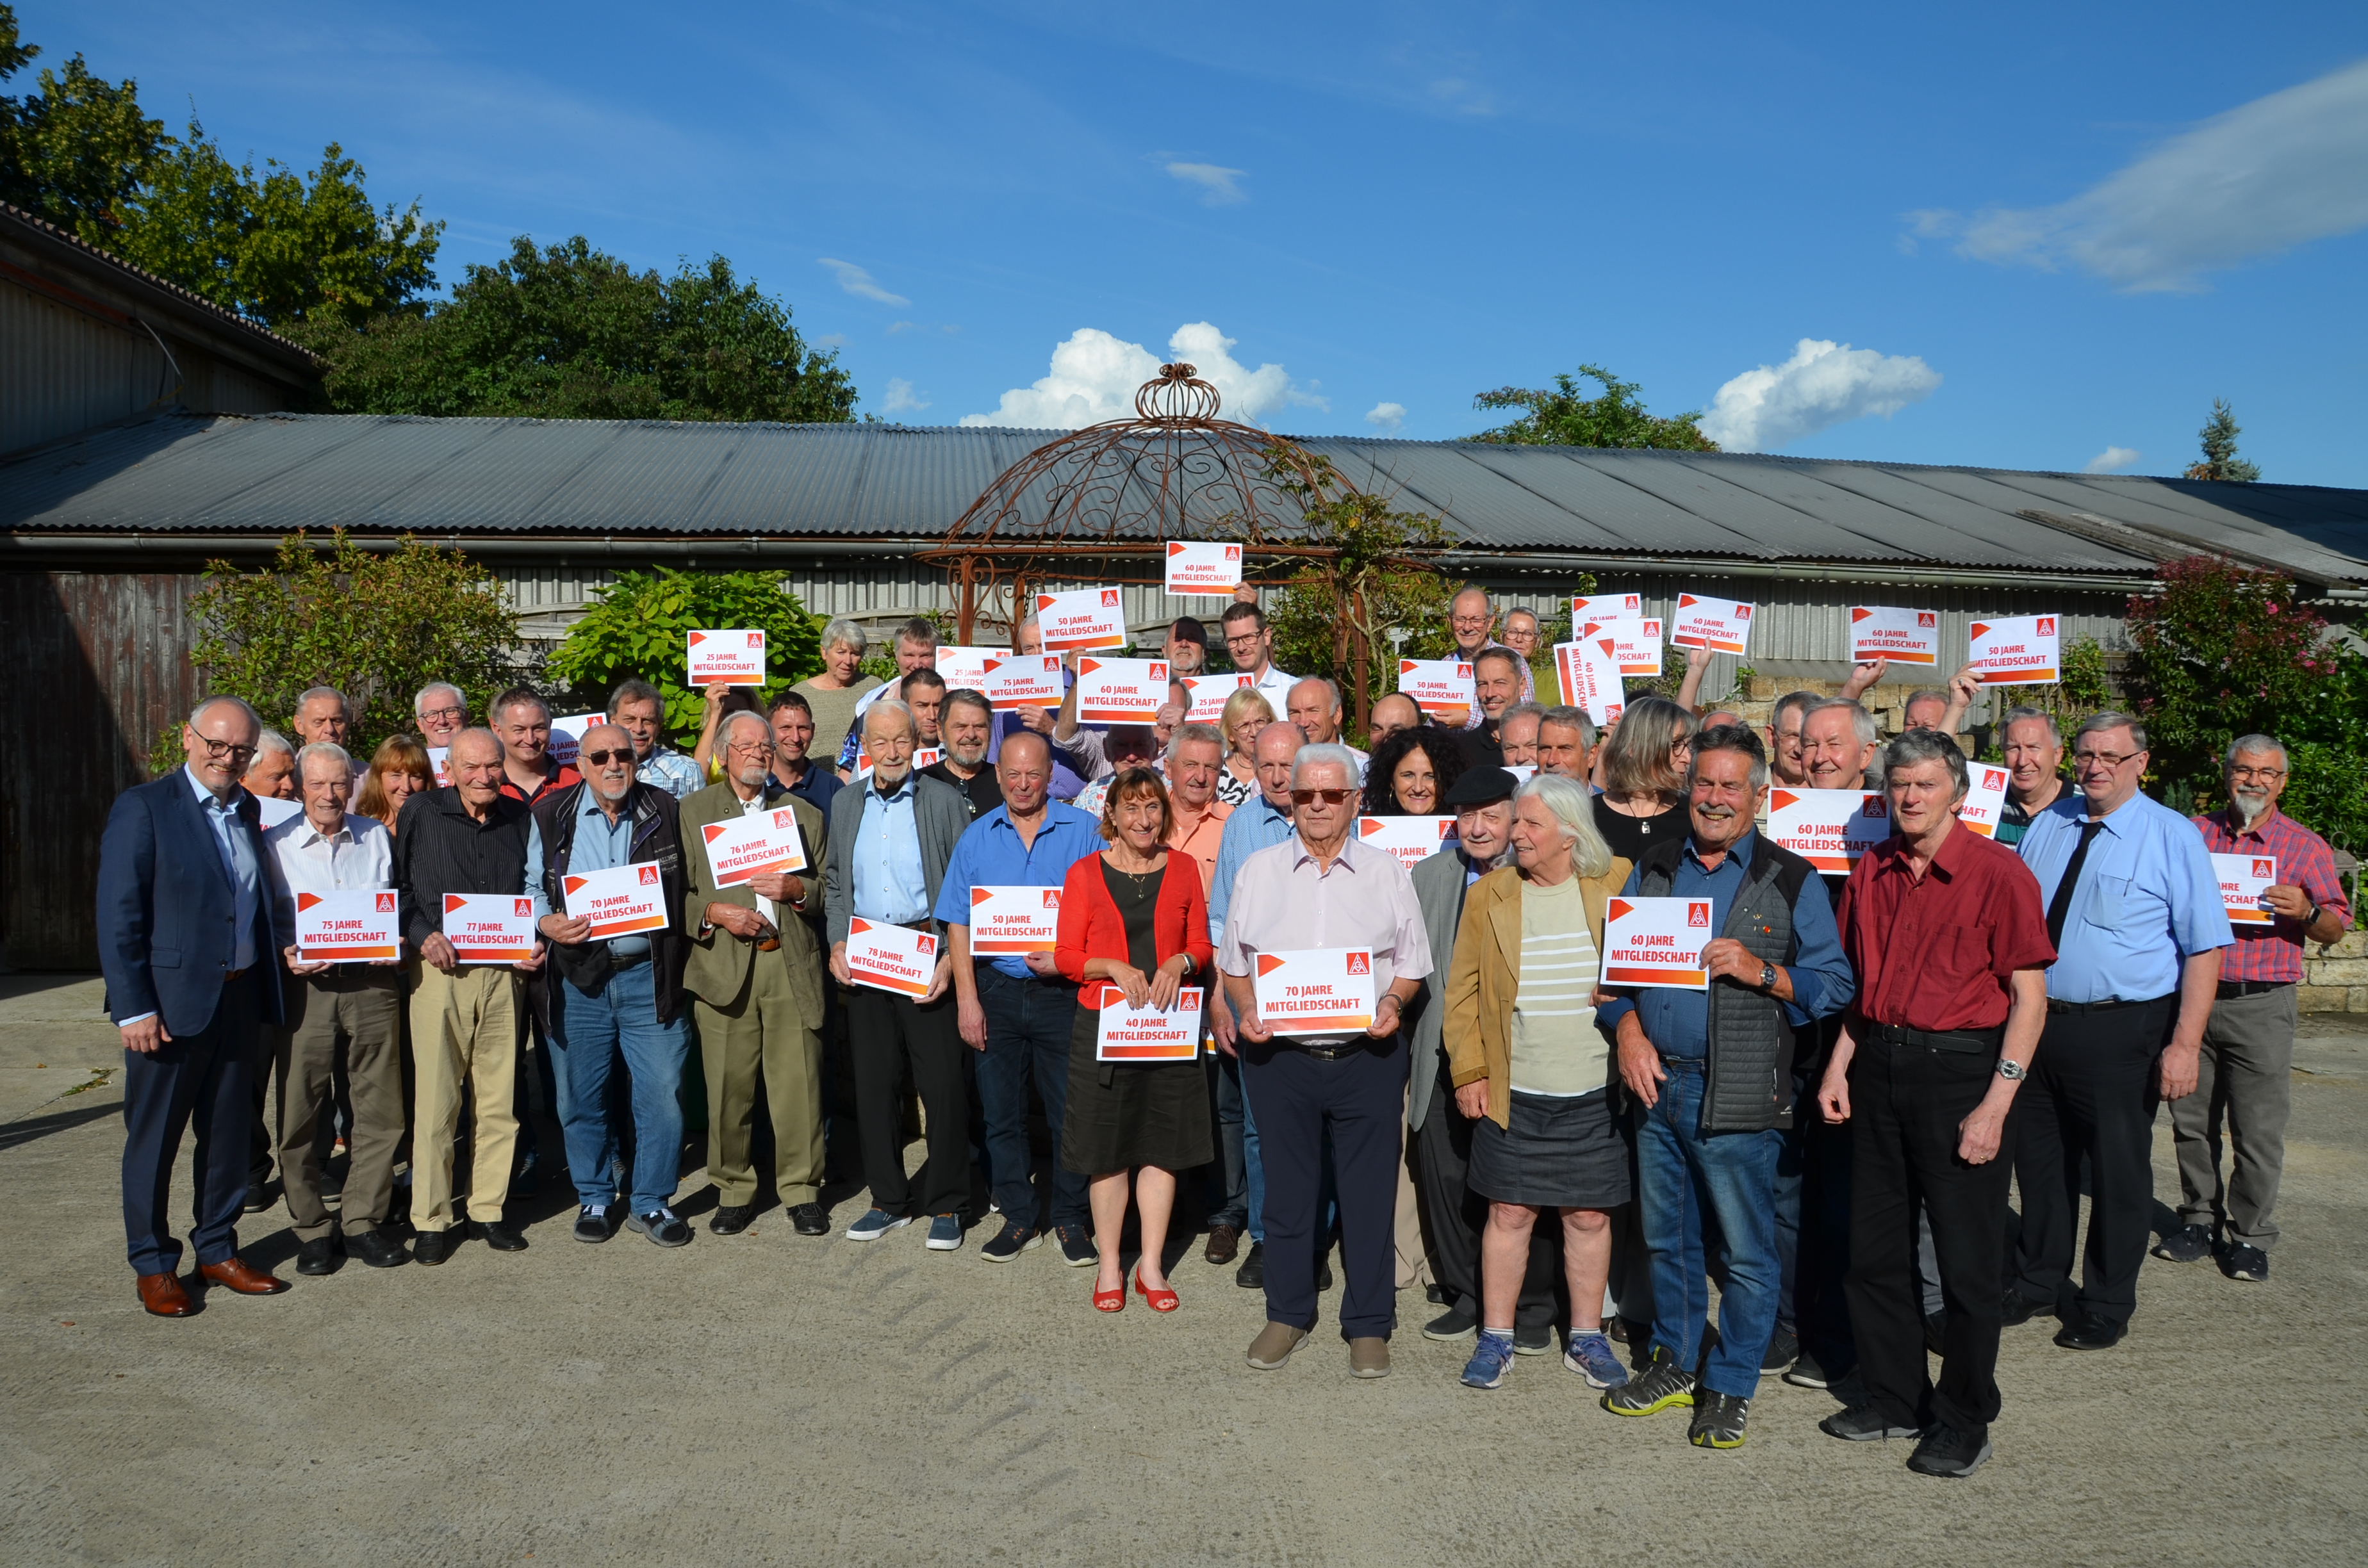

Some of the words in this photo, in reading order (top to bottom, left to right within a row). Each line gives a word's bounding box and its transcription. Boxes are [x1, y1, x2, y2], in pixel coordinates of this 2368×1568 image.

[1070, 616, 1092, 626] JAHRE
[1702, 619, 1724, 628] JAHRE
[1046, 624, 1112, 637] MITGLIEDSCHAFT
[1679, 625, 1738, 639] MITGLIEDSCHAFT
[1857, 639, 1927, 649] MITGLIEDSCHAFT
[2001, 645, 2025, 655] JAHRE
[1585, 662, 1593, 673] 40
[1014, 678, 1034, 687] JAHRE
[1572, 648, 1588, 711] MITGLIEDSCHA
[991, 687, 1053, 696] MITGLIEDSCHAFT
[1114, 686, 1138, 695] JAHRE
[1585, 674, 1597, 698] JAHRE
[1084, 697, 1157, 706] MITGLIEDSCHAFT
[1186, 707, 1224, 716] MITGLIEDS
[1798, 824, 1812, 834] 60
[1814, 825, 1848, 836] JAHRE
[742, 839, 767, 853] JAHRE
[718, 845, 789, 869] MITGLIEDSCHAFT
[1399, 847, 1427, 858] JAHRE
[591, 900, 602, 908] 70
[604, 895, 630, 908] JAHRE
[576, 903, 652, 922] TGLIEDSCHAFT
[335, 920, 363, 931] JAHRE
[1005, 915, 1031, 925] JAHRE
[479, 923, 503, 933] JAHRE
[977, 927, 1053, 936] MITGLIEDSCHAFT
[304, 932, 386, 943] MITGLIEDSCHAFT
[450, 935, 523, 944] MITGLIEDSCHAFT
[1631, 935, 1643, 945] 60
[1645, 935, 1674, 947] JAHRE
[869, 947, 878, 956] 78
[879, 951, 903, 962] JAHRE
[1611, 950, 1697, 963] MITGLIEDSCHAFT
[851, 955, 922, 978] MITGLIEDSCHAFT
[1285, 986, 1298, 996] 70
[1301, 985, 1333, 997] JAHRE
[1266, 999, 1360, 1012] MITGLIEDSCHAFT
[1126, 1018, 1138, 1027] 40
[1140, 1018, 1167, 1029] JAHRE
[1107, 1031, 1187, 1040] MITGLIEDSCHAFT
